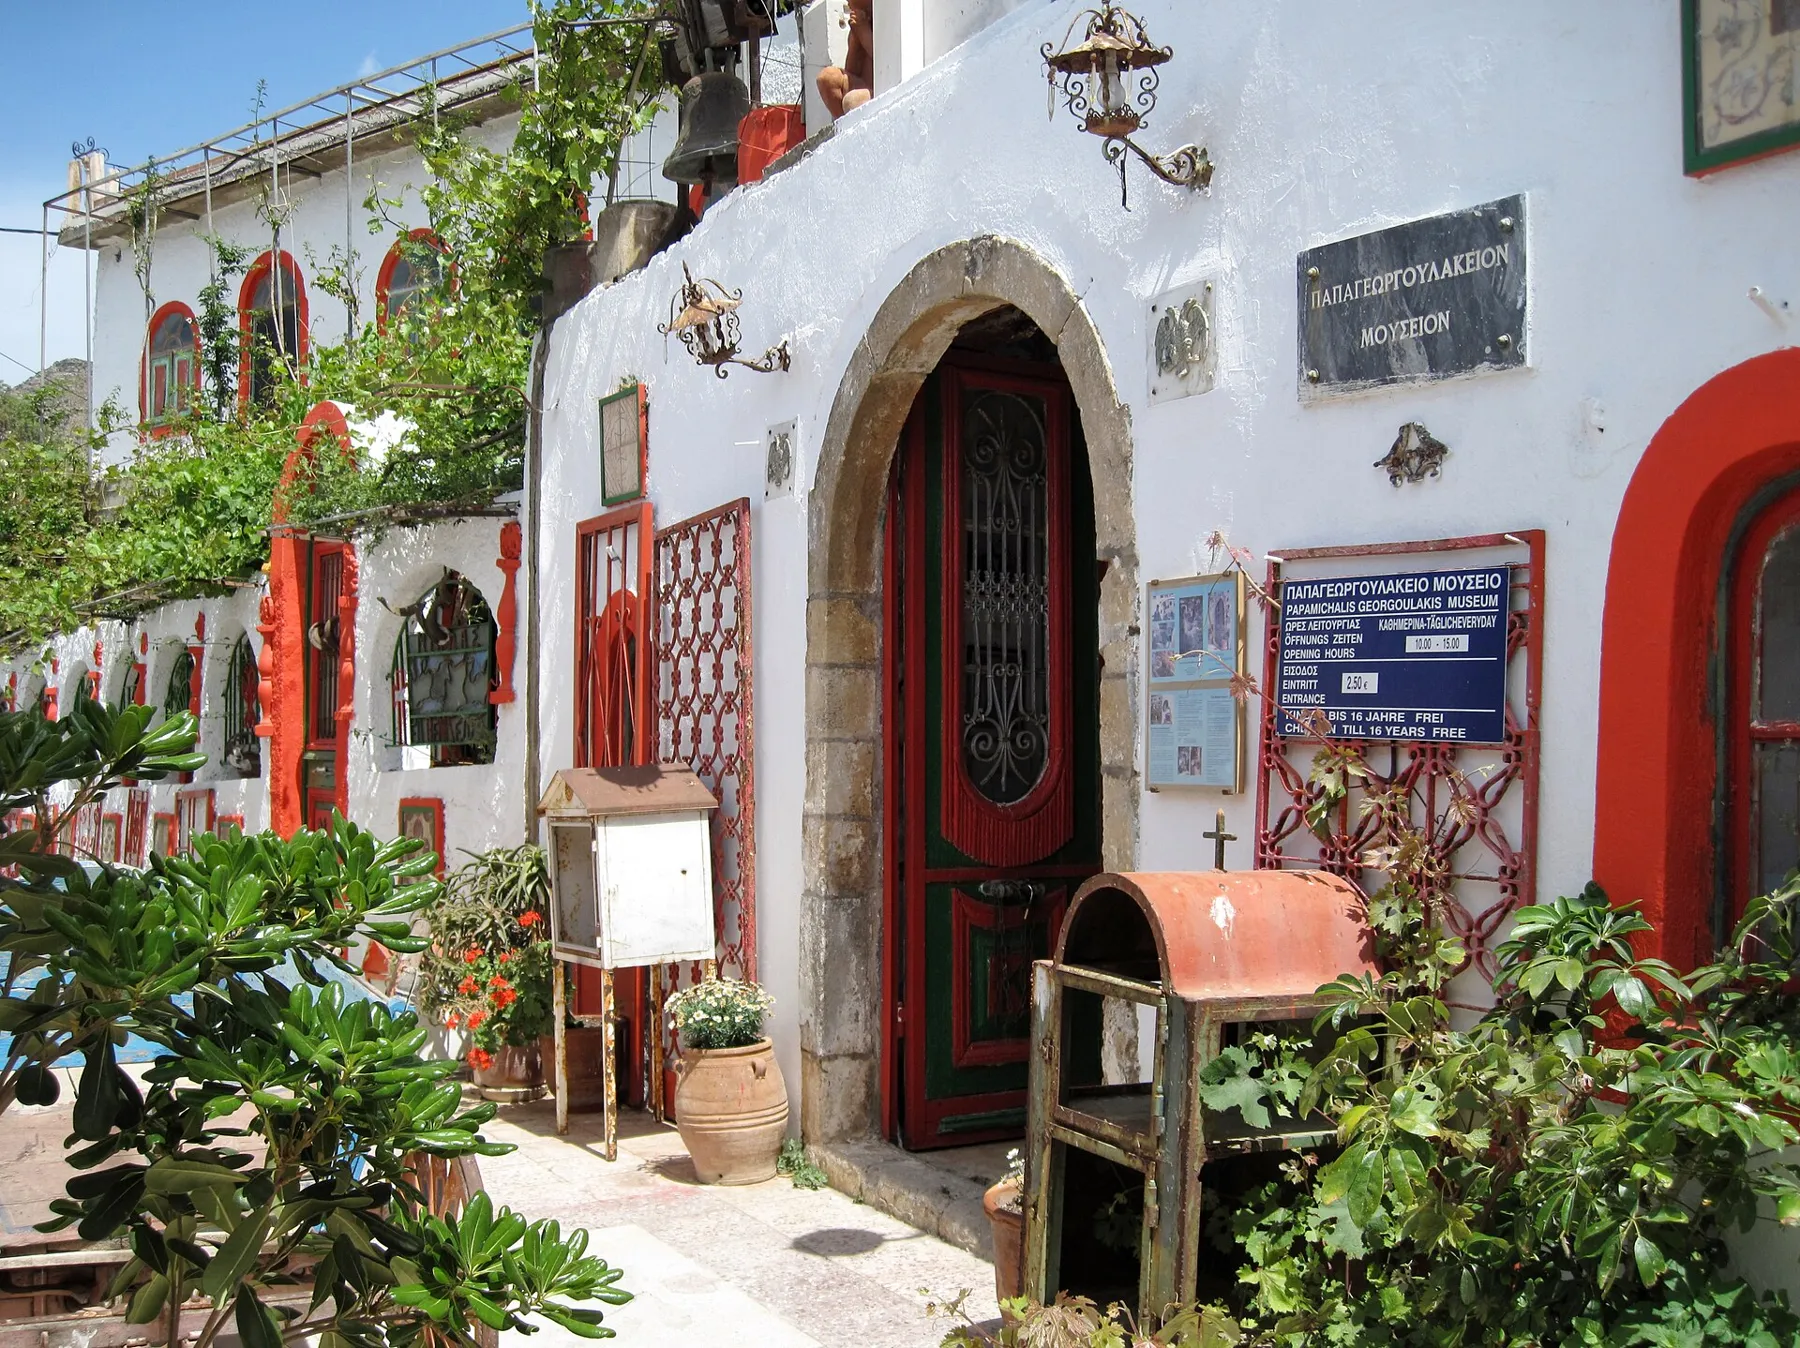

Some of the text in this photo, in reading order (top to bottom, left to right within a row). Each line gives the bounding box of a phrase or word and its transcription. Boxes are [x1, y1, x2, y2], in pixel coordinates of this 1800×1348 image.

[1311, 243, 1509, 309] ΠΑΠΑΓΕΩΡΓΟΥΛΑΚΕΙΟΝ
[1360, 311, 1450, 349] ΜΟΥΣΕΙΟΝ
[1286, 573, 1502, 600] ΠΑΠΑΓΕΩΡΓΟΥΛΑΚΕΙΟ ΜΟΥΣΕΙΟ
[1286, 594, 1499, 616] PAPAMICHALIS GEORGOULAKIS MUSEUM
[1285, 619, 1361, 632] ΩΡΕΣ ΛΕΙΤΟΥΡΓΙΑΣ
[1284, 632, 1363, 646] ÖFFNUNGS ZEITEN
[1415, 637, 1432, 650] 10.00
[1443, 637, 1460, 650] 15.00
[1284, 648, 1355, 660] OPENING HOURS
[1283, 666, 1318, 676] ΕΙΣΟΔΟΣ
[1282, 680, 1318, 690] EINTRITT
[1282, 694, 1326, 704] ENTRANCE
[1329, 711, 1347, 721] BIS
[1350, 711, 1363, 722] 16
[1366, 712, 1405, 723] JAHRE
[1415, 713, 1444, 723] FREI
[1342, 725, 1366, 736] TILL
[1369, 725, 1382, 736] 16
[1385, 726, 1426, 738] YEARS
[1432, 727, 1466, 739] FREE
